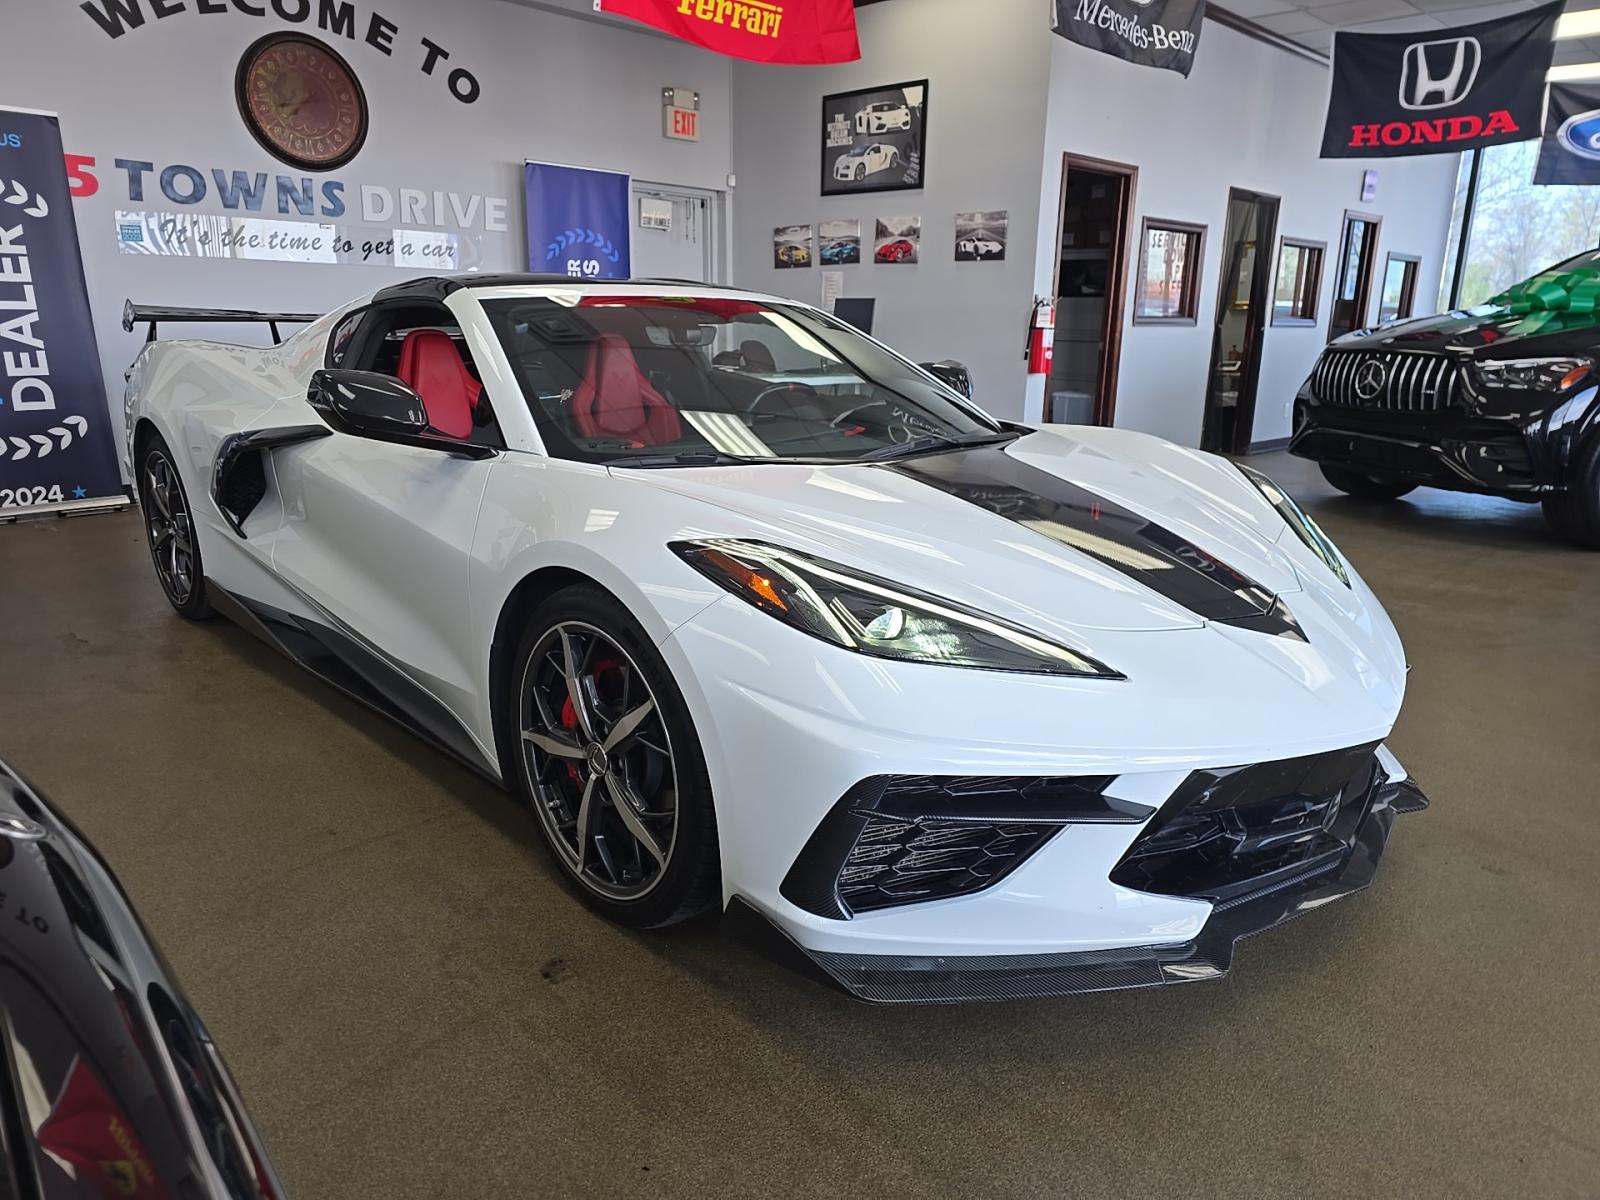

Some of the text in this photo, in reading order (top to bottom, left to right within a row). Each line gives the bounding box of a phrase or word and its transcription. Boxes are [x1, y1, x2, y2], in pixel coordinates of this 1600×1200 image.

[1073, 0, 1195, 54] Mercedes-Benz
[420, 36, 481, 104] TO
[673, 109, 697, 138] EXIT
[1347, 109, 1520, 149] HONDA
[65, 154, 510, 233] 5 TOWNS DRIVE
[221, 225, 260, 248] the
[269, 229, 322, 252] time
[332, 235, 355, 254] to
[361, 237, 395, 267] get
[400, 242, 416, 257] a
[421, 240, 458, 259] car
[0, 484, 65, 508] 2024
